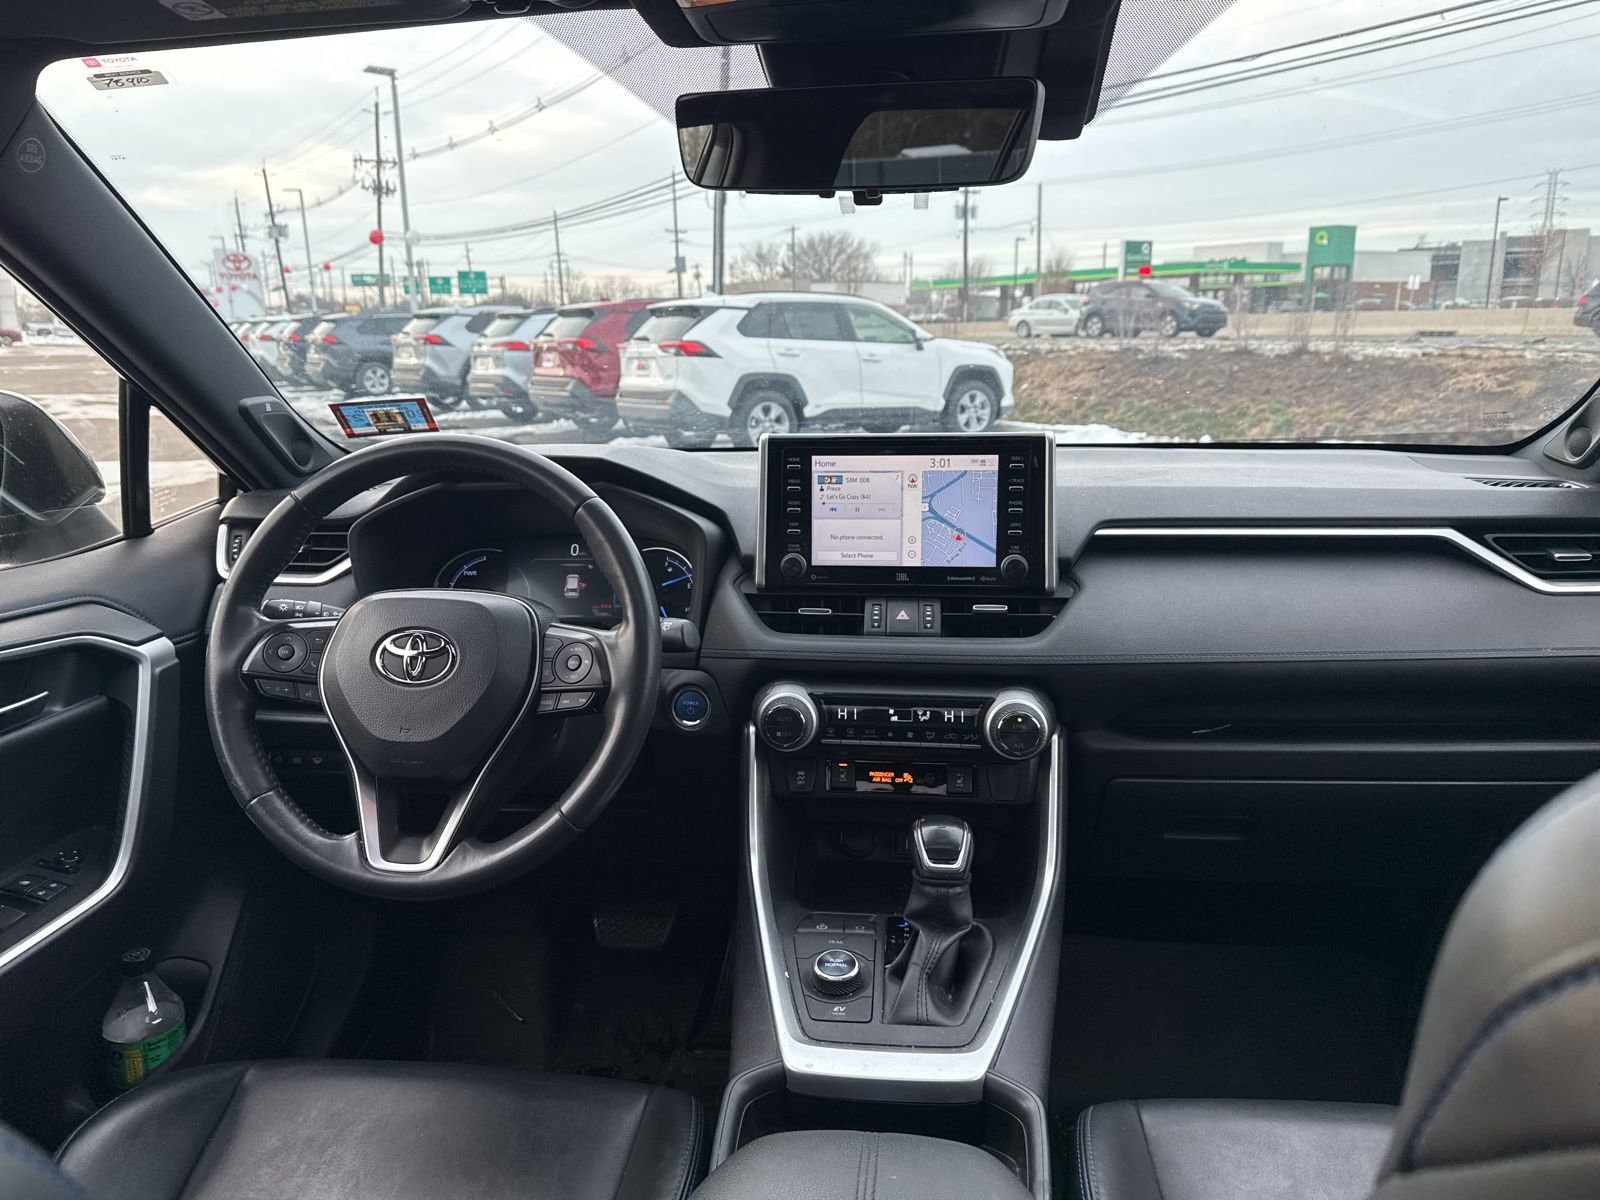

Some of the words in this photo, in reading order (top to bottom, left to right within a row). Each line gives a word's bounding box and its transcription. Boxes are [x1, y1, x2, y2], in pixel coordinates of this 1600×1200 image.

[815, 459, 836, 467] Home
[929, 458, 951, 469] 3:01
[839, 533, 856, 541] phone
[570, 543, 580, 557] 0
[896, 573, 910, 581] JBL
